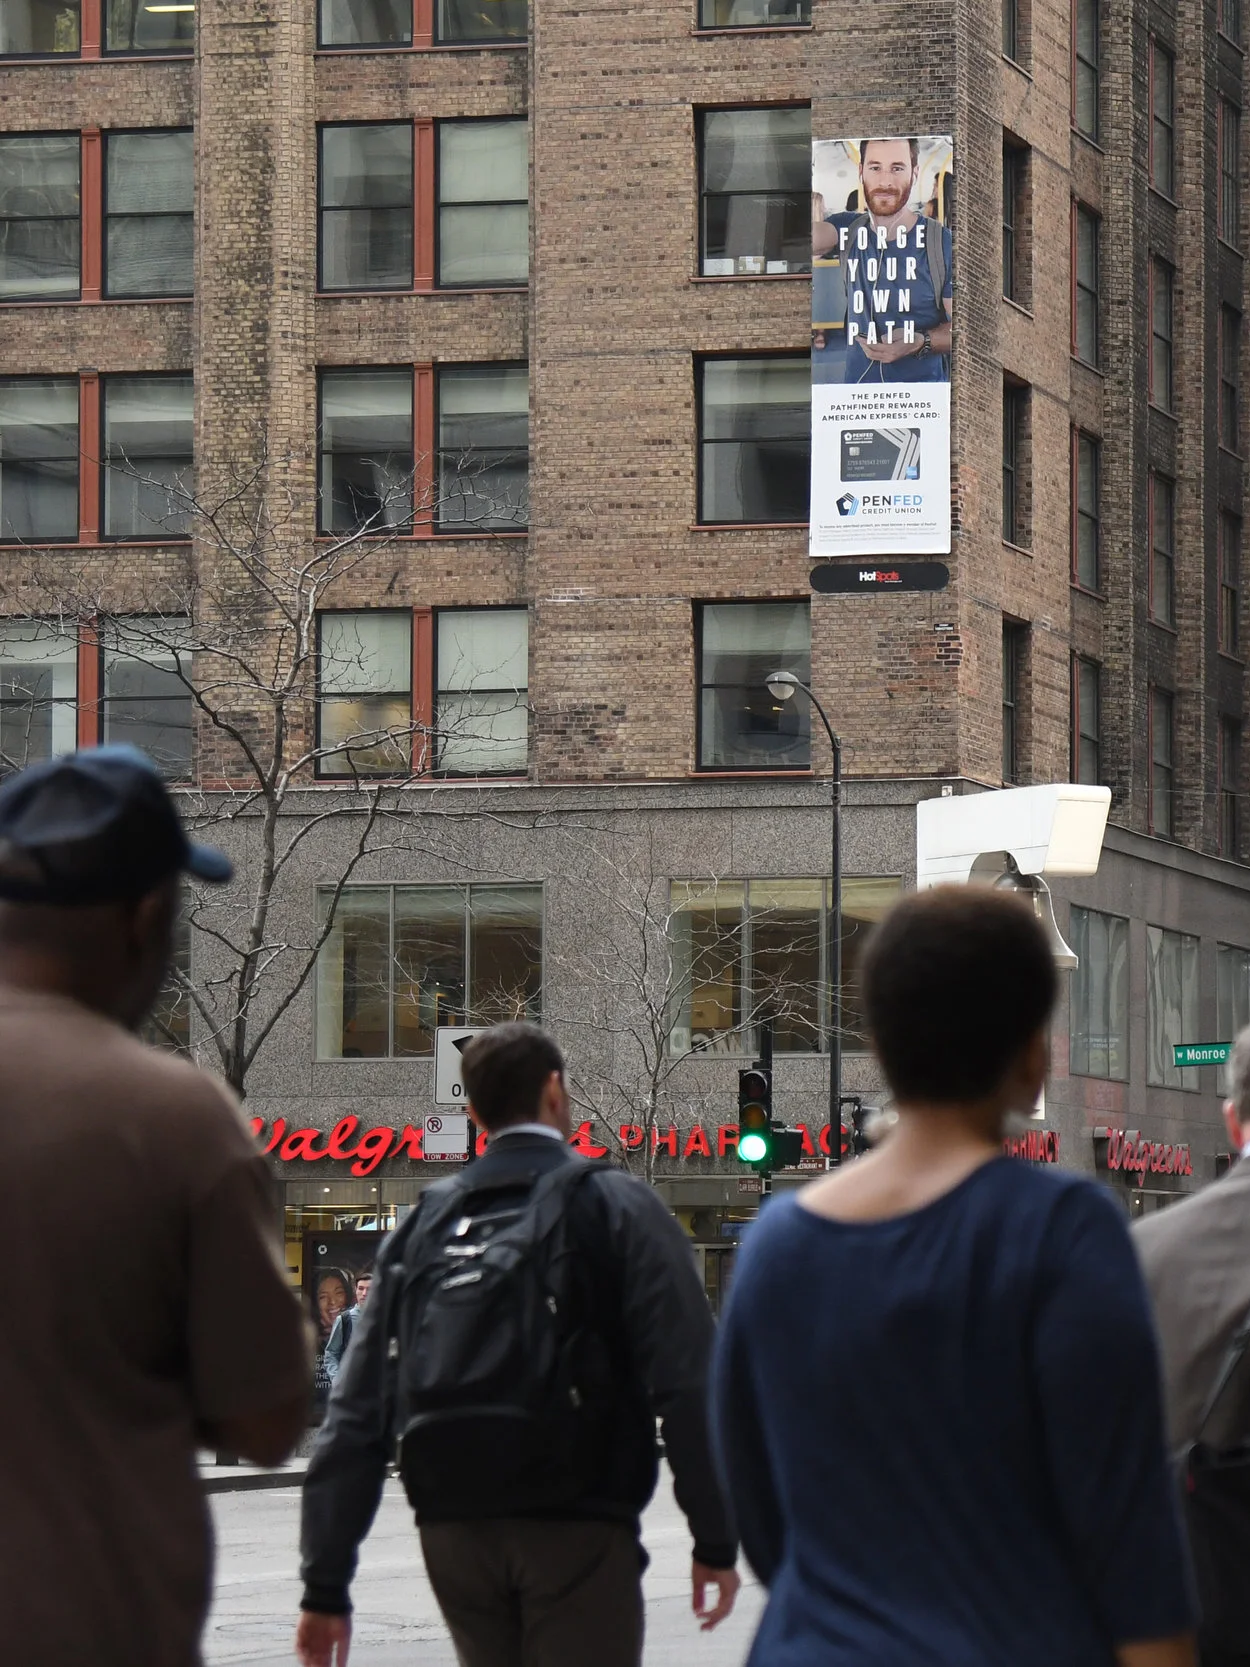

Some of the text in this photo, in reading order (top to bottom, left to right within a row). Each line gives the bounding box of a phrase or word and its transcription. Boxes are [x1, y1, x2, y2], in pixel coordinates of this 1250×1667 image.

[839, 224, 926, 250] FORGE
[847, 256, 917, 282] YOUR
[852, 288, 910, 314] OWN
[848, 320, 915, 345] PATH
[821, 412, 867, 421] AMERICAN
[913, 411, 941, 419] CARD:
[830, 402, 932, 411] PATHFINDER REWARDS
[862, 495, 923, 506] PENFED
[1186, 1048, 1226, 1061] Monroe
[444, 1152, 464, 1160] ZONE
[1107, 1127, 1193, 1188] Walgreens
